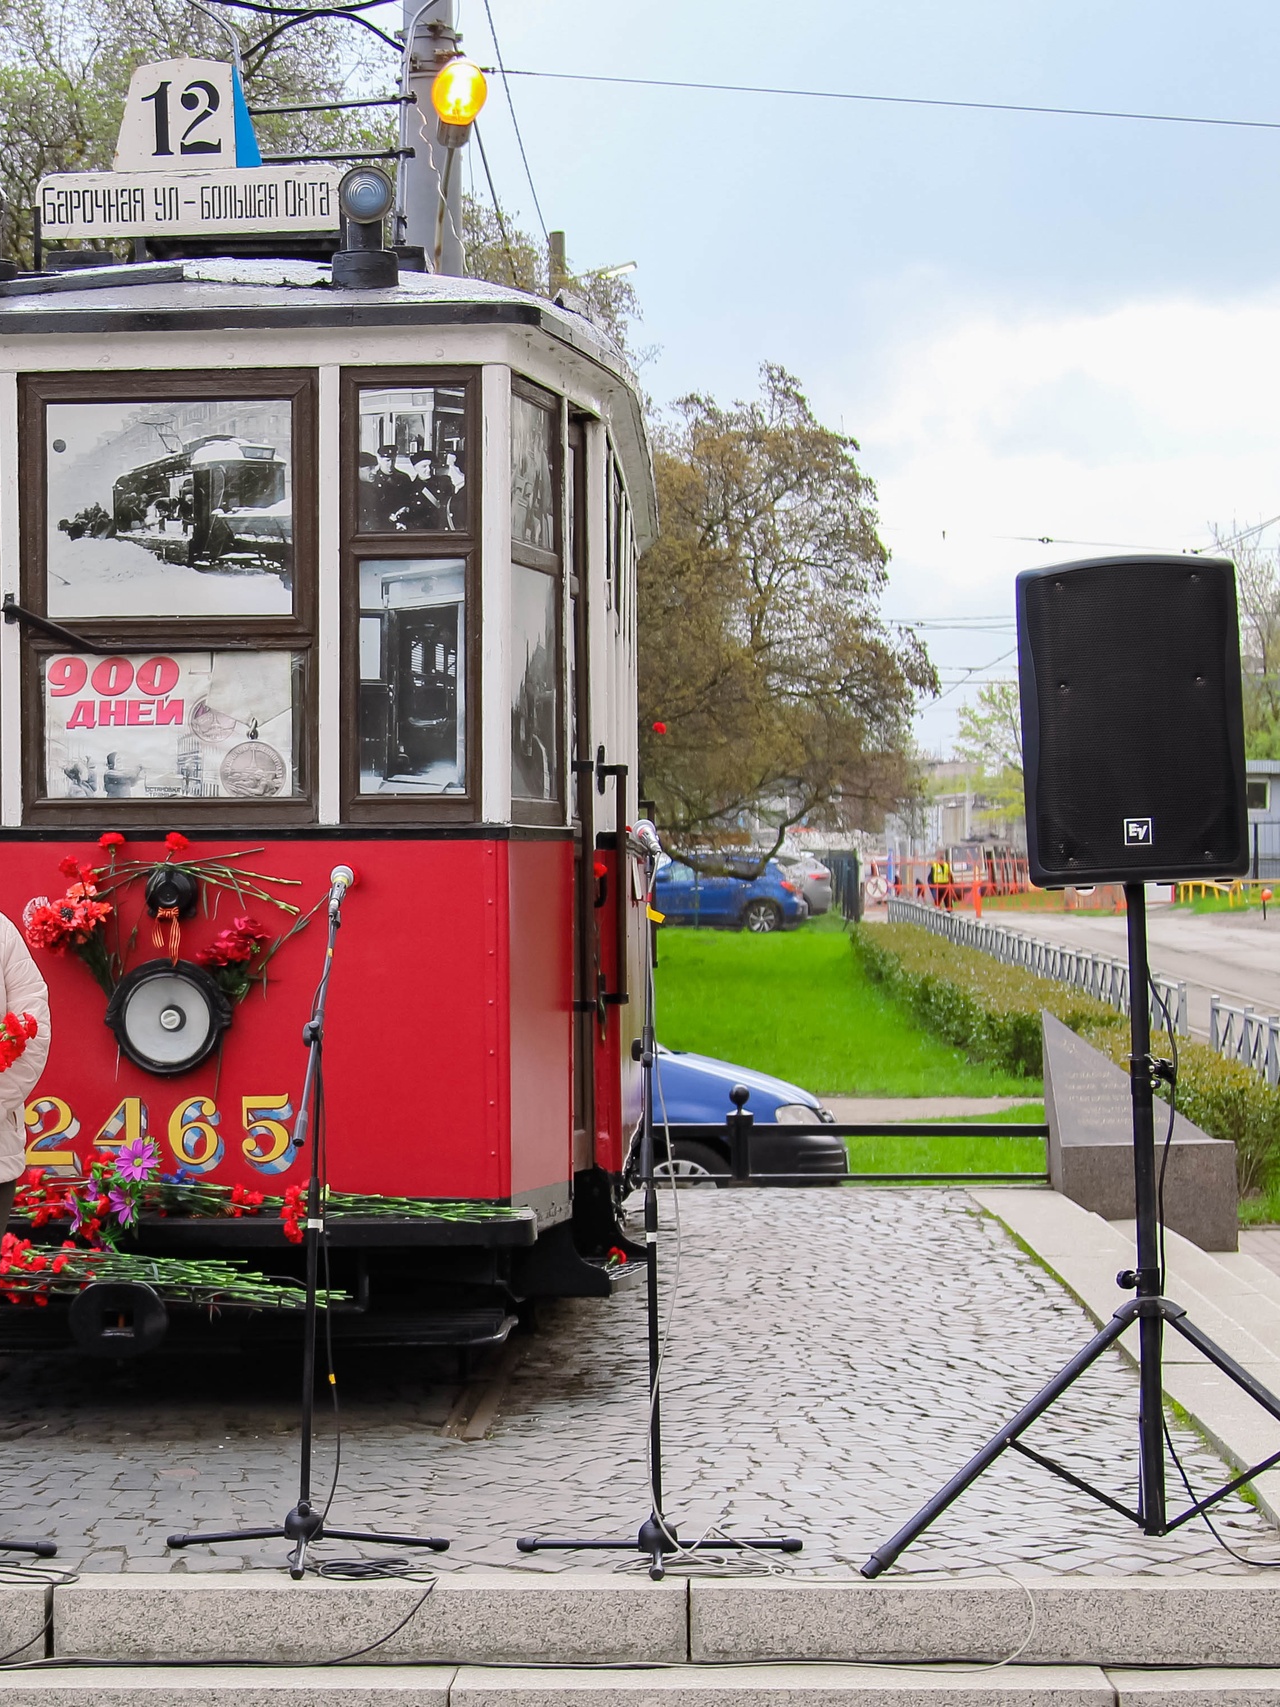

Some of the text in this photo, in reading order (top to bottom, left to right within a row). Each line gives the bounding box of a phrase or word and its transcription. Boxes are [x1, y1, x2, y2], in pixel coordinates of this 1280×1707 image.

[141, 80, 221, 156] 12
[47, 656, 180, 697] 900
[66, 695, 185, 729] ДНЕЙ
[24, 1092, 296, 1173] 2465
